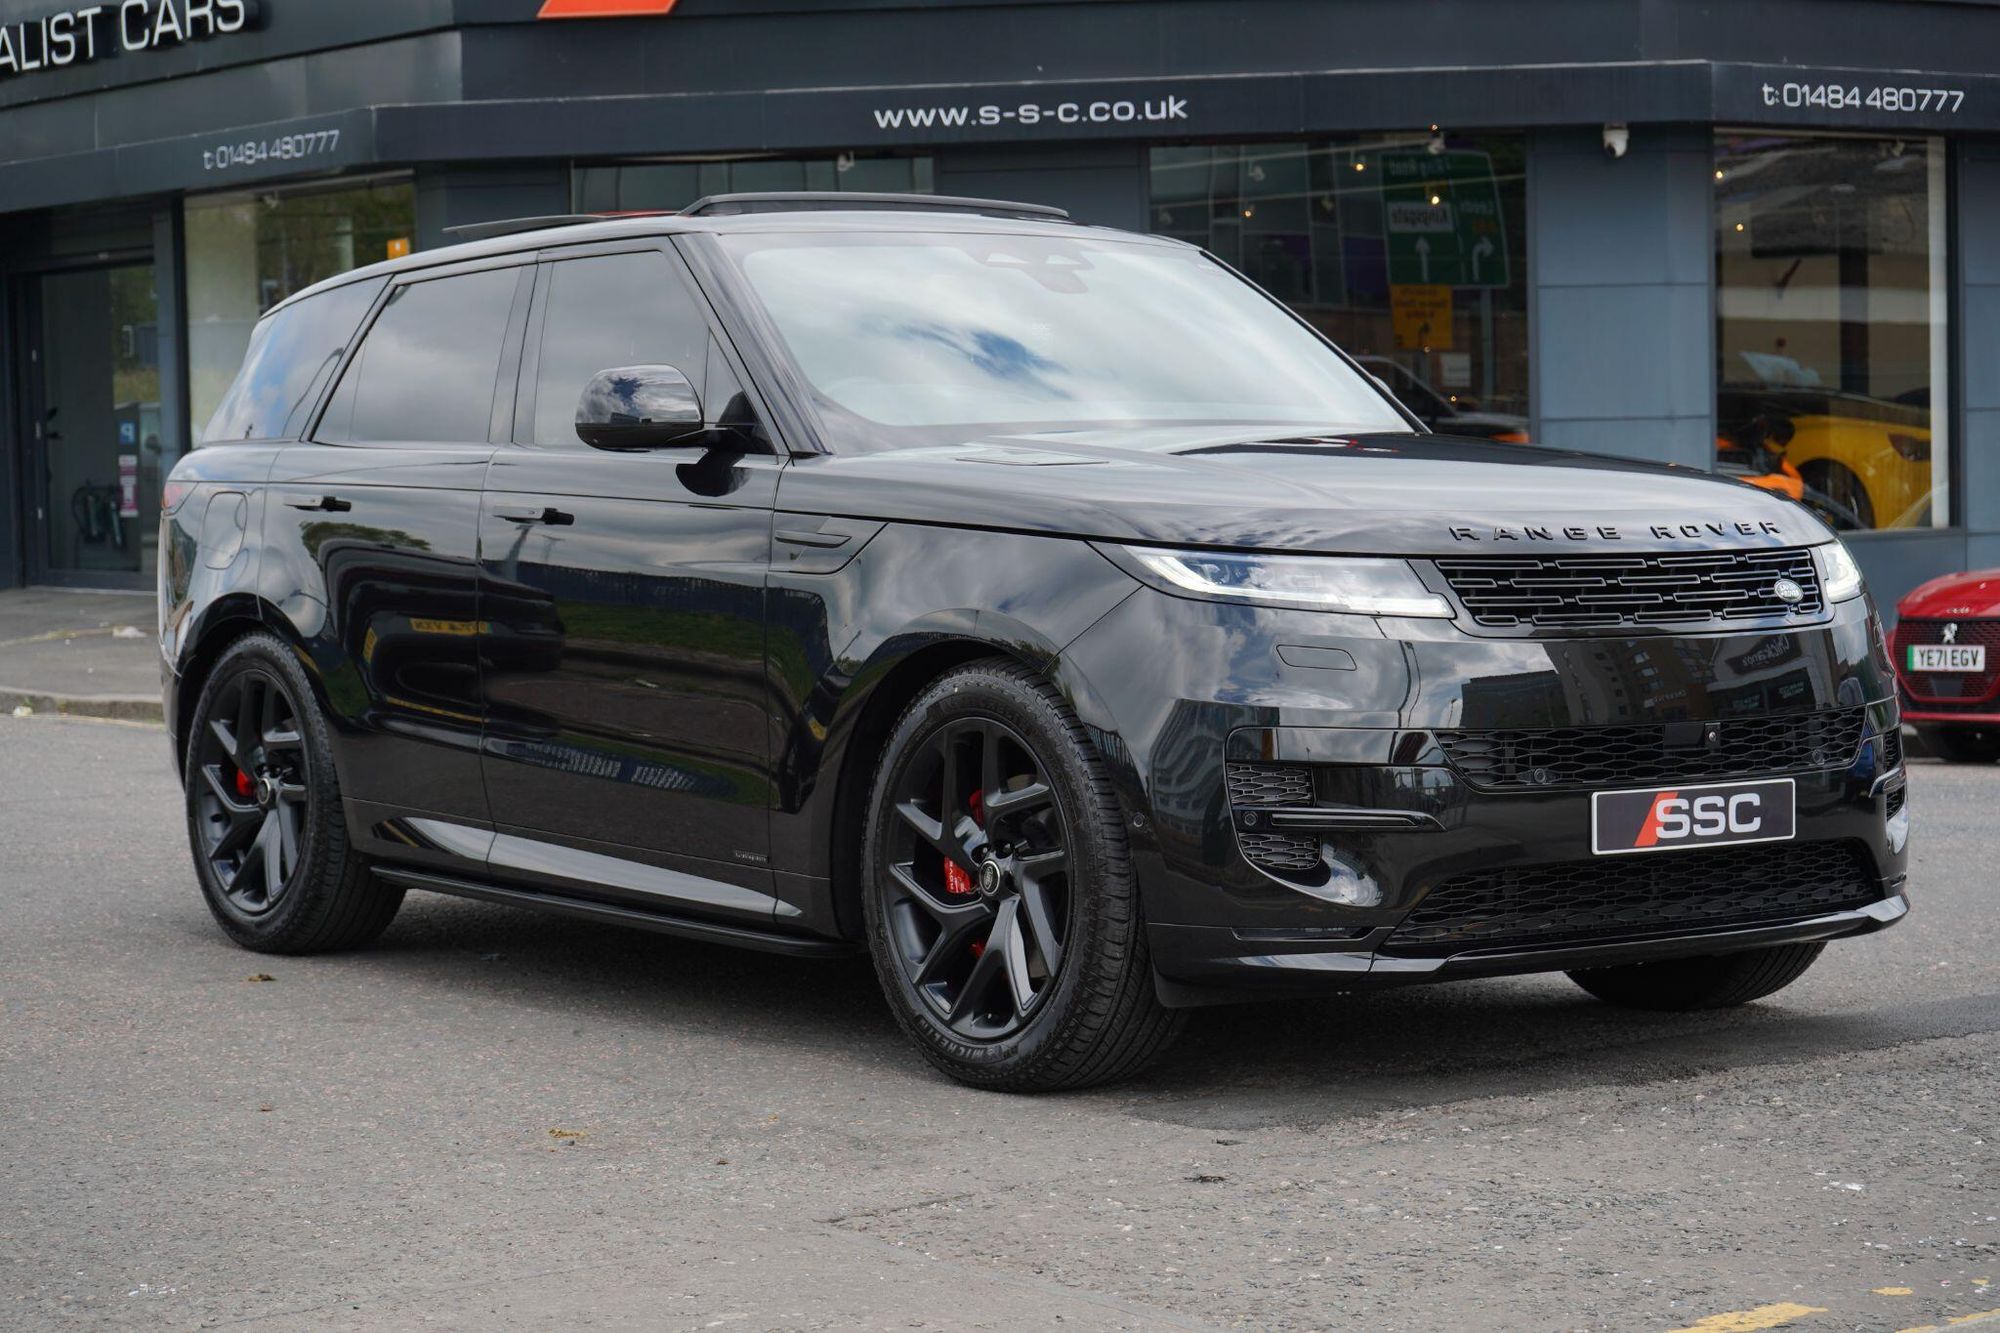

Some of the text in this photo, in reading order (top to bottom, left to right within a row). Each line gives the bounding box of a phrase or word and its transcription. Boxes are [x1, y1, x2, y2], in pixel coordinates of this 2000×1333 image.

[121, 0, 245, 51] CARS
[873, 95, 1188, 128] www.s-s-c.co.uk
[1449, 521, 1780, 541] RANGE ROVER
[1919, 649, 1979, 667] YE71 EGV
[1656, 792, 1762, 839] SSC
